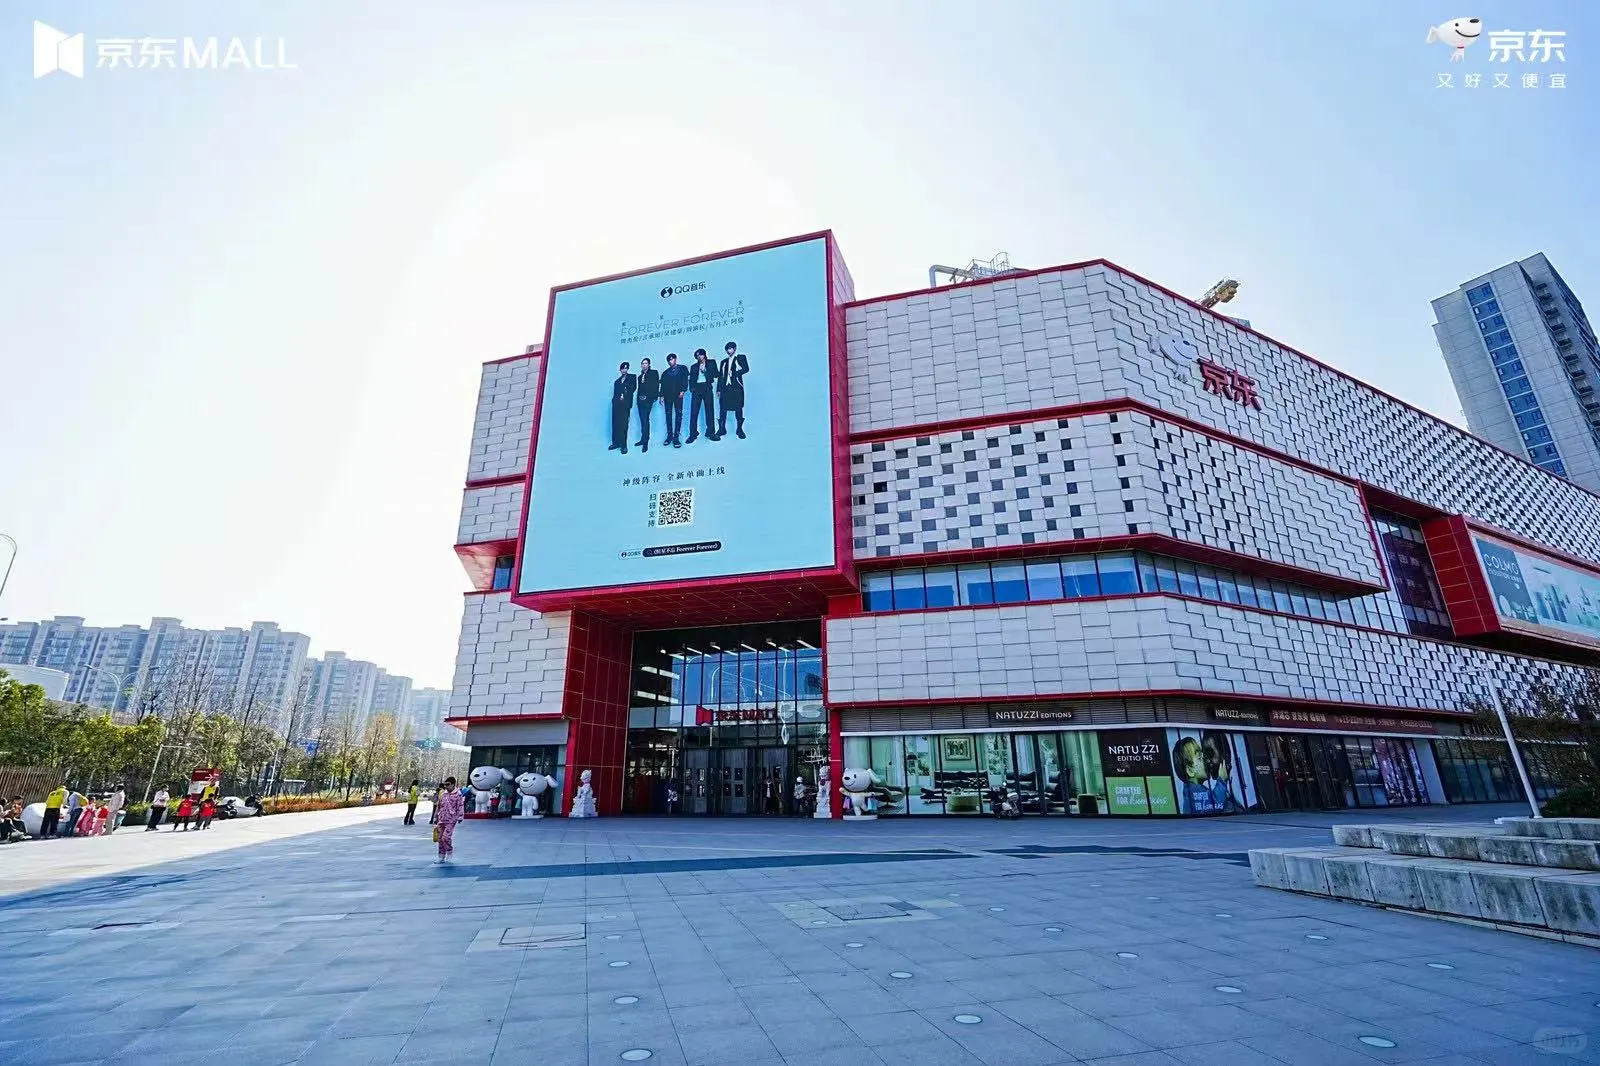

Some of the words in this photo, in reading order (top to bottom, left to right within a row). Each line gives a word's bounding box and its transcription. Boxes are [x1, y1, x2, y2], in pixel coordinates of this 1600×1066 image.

[674, 281, 706, 294] QQ音乐
[621, 319, 679, 336] FOREVER
[684, 307, 744, 325] FOREVER
[1197, 358, 1262, 411] 京东
[667, 465, 726, 481] 全新单曲上线
[1484, 553, 1519, 575] COLMO
[995, 711, 1039, 720] NATUZZI
